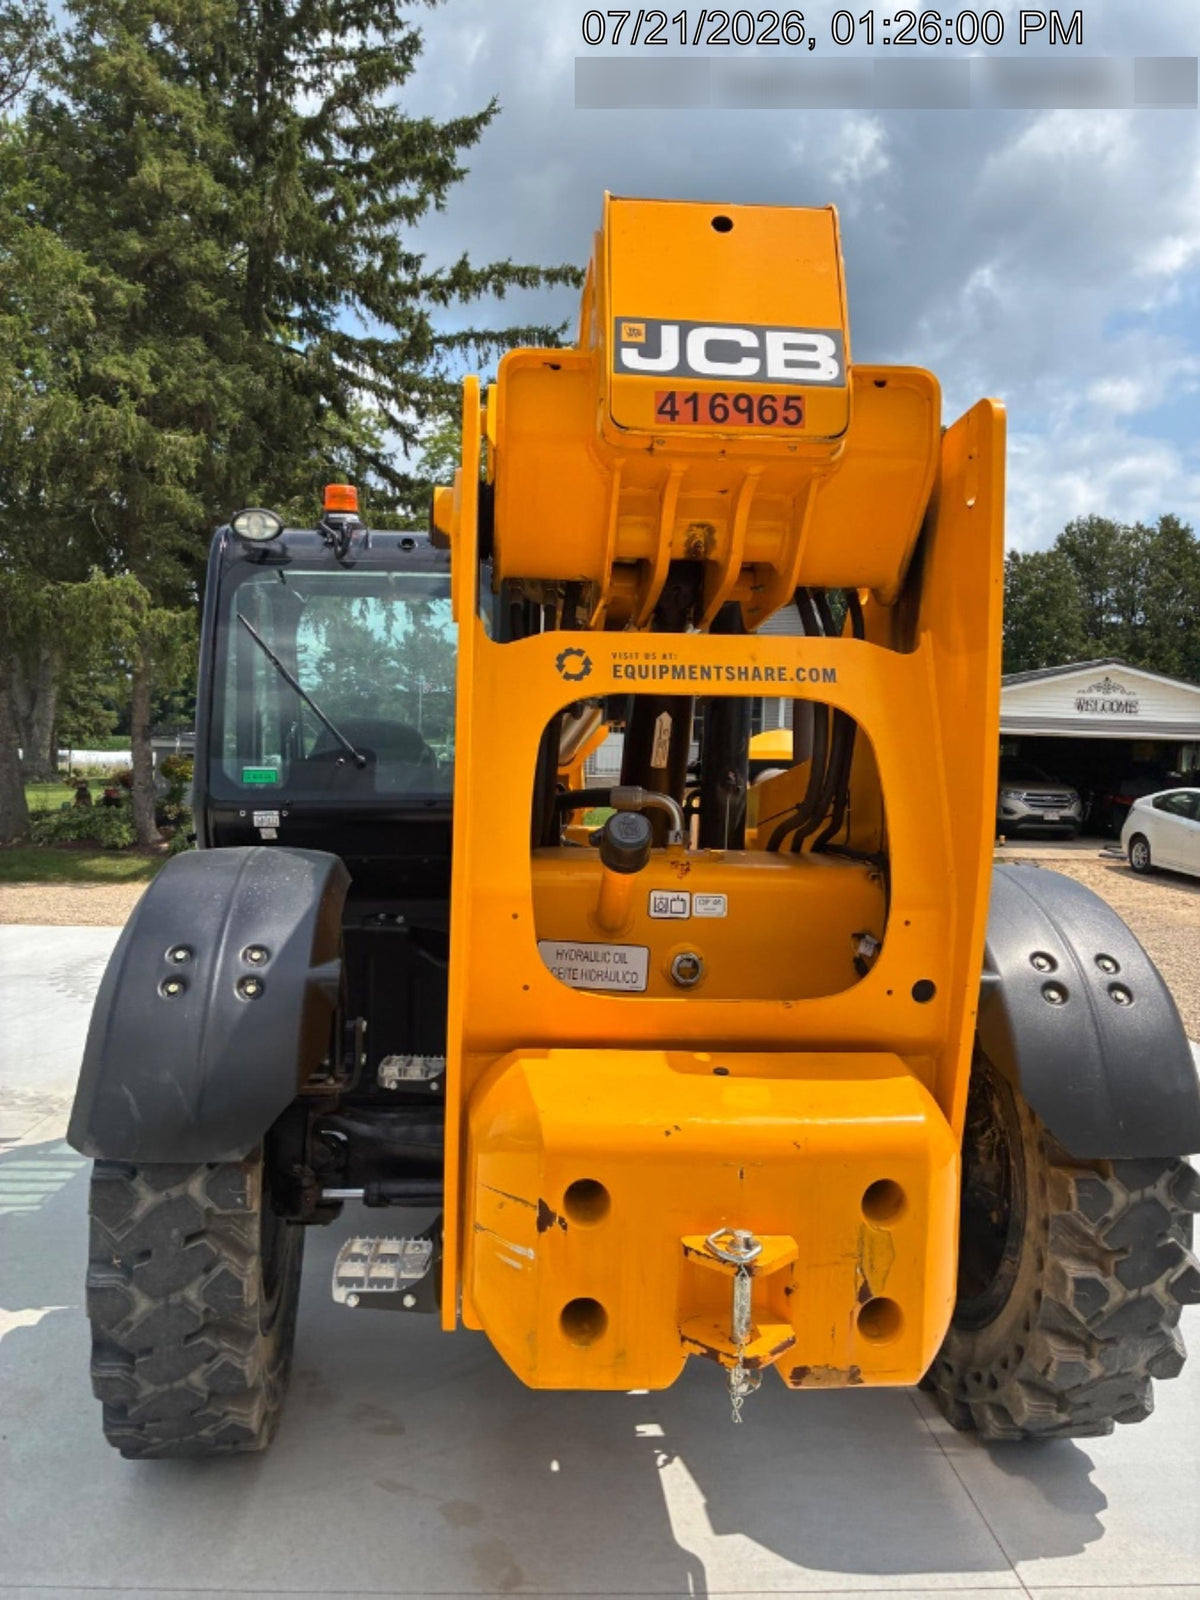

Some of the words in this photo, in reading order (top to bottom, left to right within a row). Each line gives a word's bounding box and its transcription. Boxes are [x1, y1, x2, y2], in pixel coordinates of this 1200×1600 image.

[620, 324, 840, 382] JCB
[657, 391, 803, 426] 416965
[611, 651, 639, 660] VISIT
[644, 652, 657, 661] US
[612, 664, 837, 683] EQUIPMENTSHARE.COM
[1075, 698, 1139, 714] WELCOME
[555, 948, 611, 964] HYDRAULIC
[613, 952, 628, 964] OIL
[549, 966, 579, 981] CEITE
